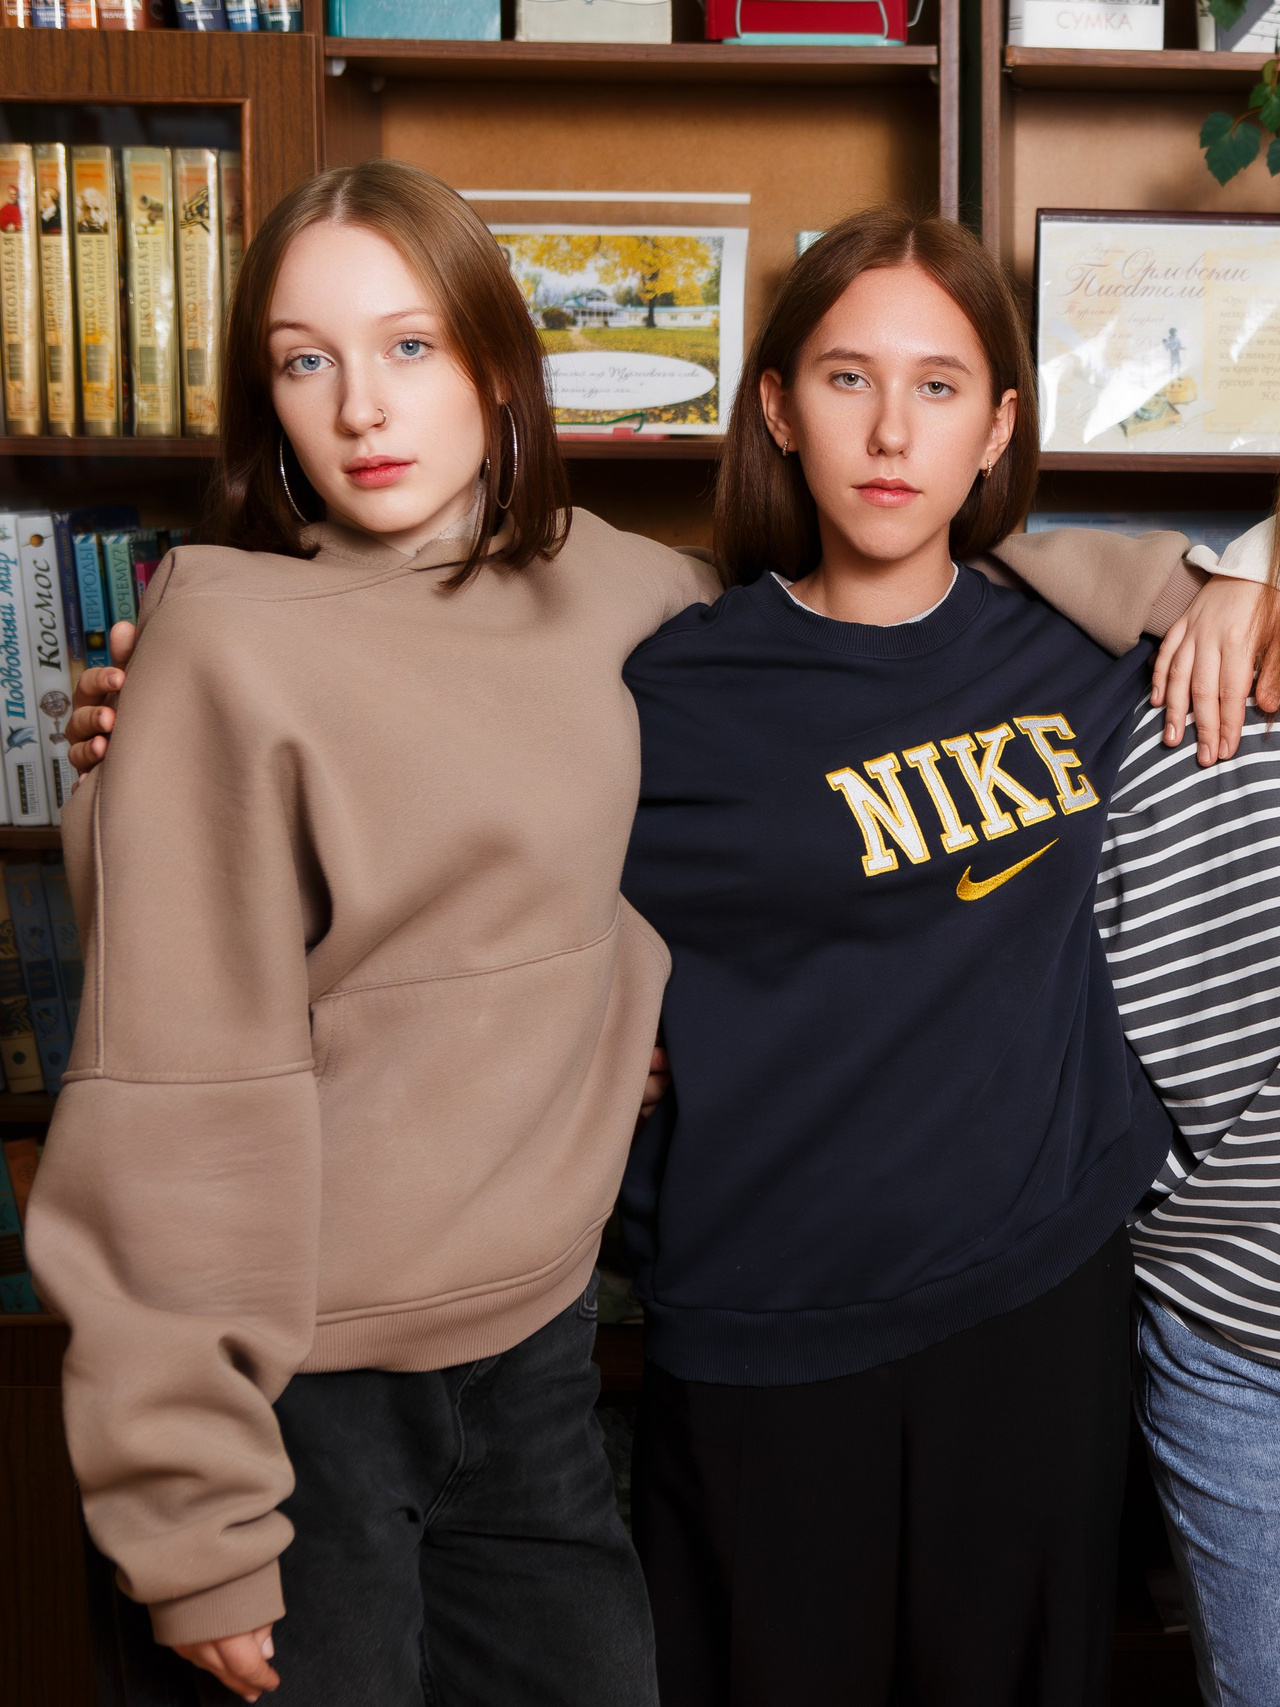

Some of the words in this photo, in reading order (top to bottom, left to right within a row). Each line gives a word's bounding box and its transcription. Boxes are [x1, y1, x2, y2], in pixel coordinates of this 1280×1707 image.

[1056, 11, 1133, 31] СУМКА
[3, 236, 18, 336] ШКОЛЬНАЯ
[44, 244, 57, 333] ШКОЛЬНАЯ
[81, 238, 97, 336] ШКОЛЬНАЯ
[97, 238, 109, 336] ЭНЦИКЛОПЕДИЯ
[137, 240, 152, 338] ШКОЛЬНАЯ
[184, 242, 199, 340] ШКОЛЬНАЯ
[1056, 263, 1207, 299] Писатели
[1121, 248, 1251, 281] Орловские
[30, 559, 63, 673] Космос
[76, 546, 97, 631] ПРИРОДЫ
[0, 598, 28, 720] Подводный
[825, 712, 1100, 877] NIKE
